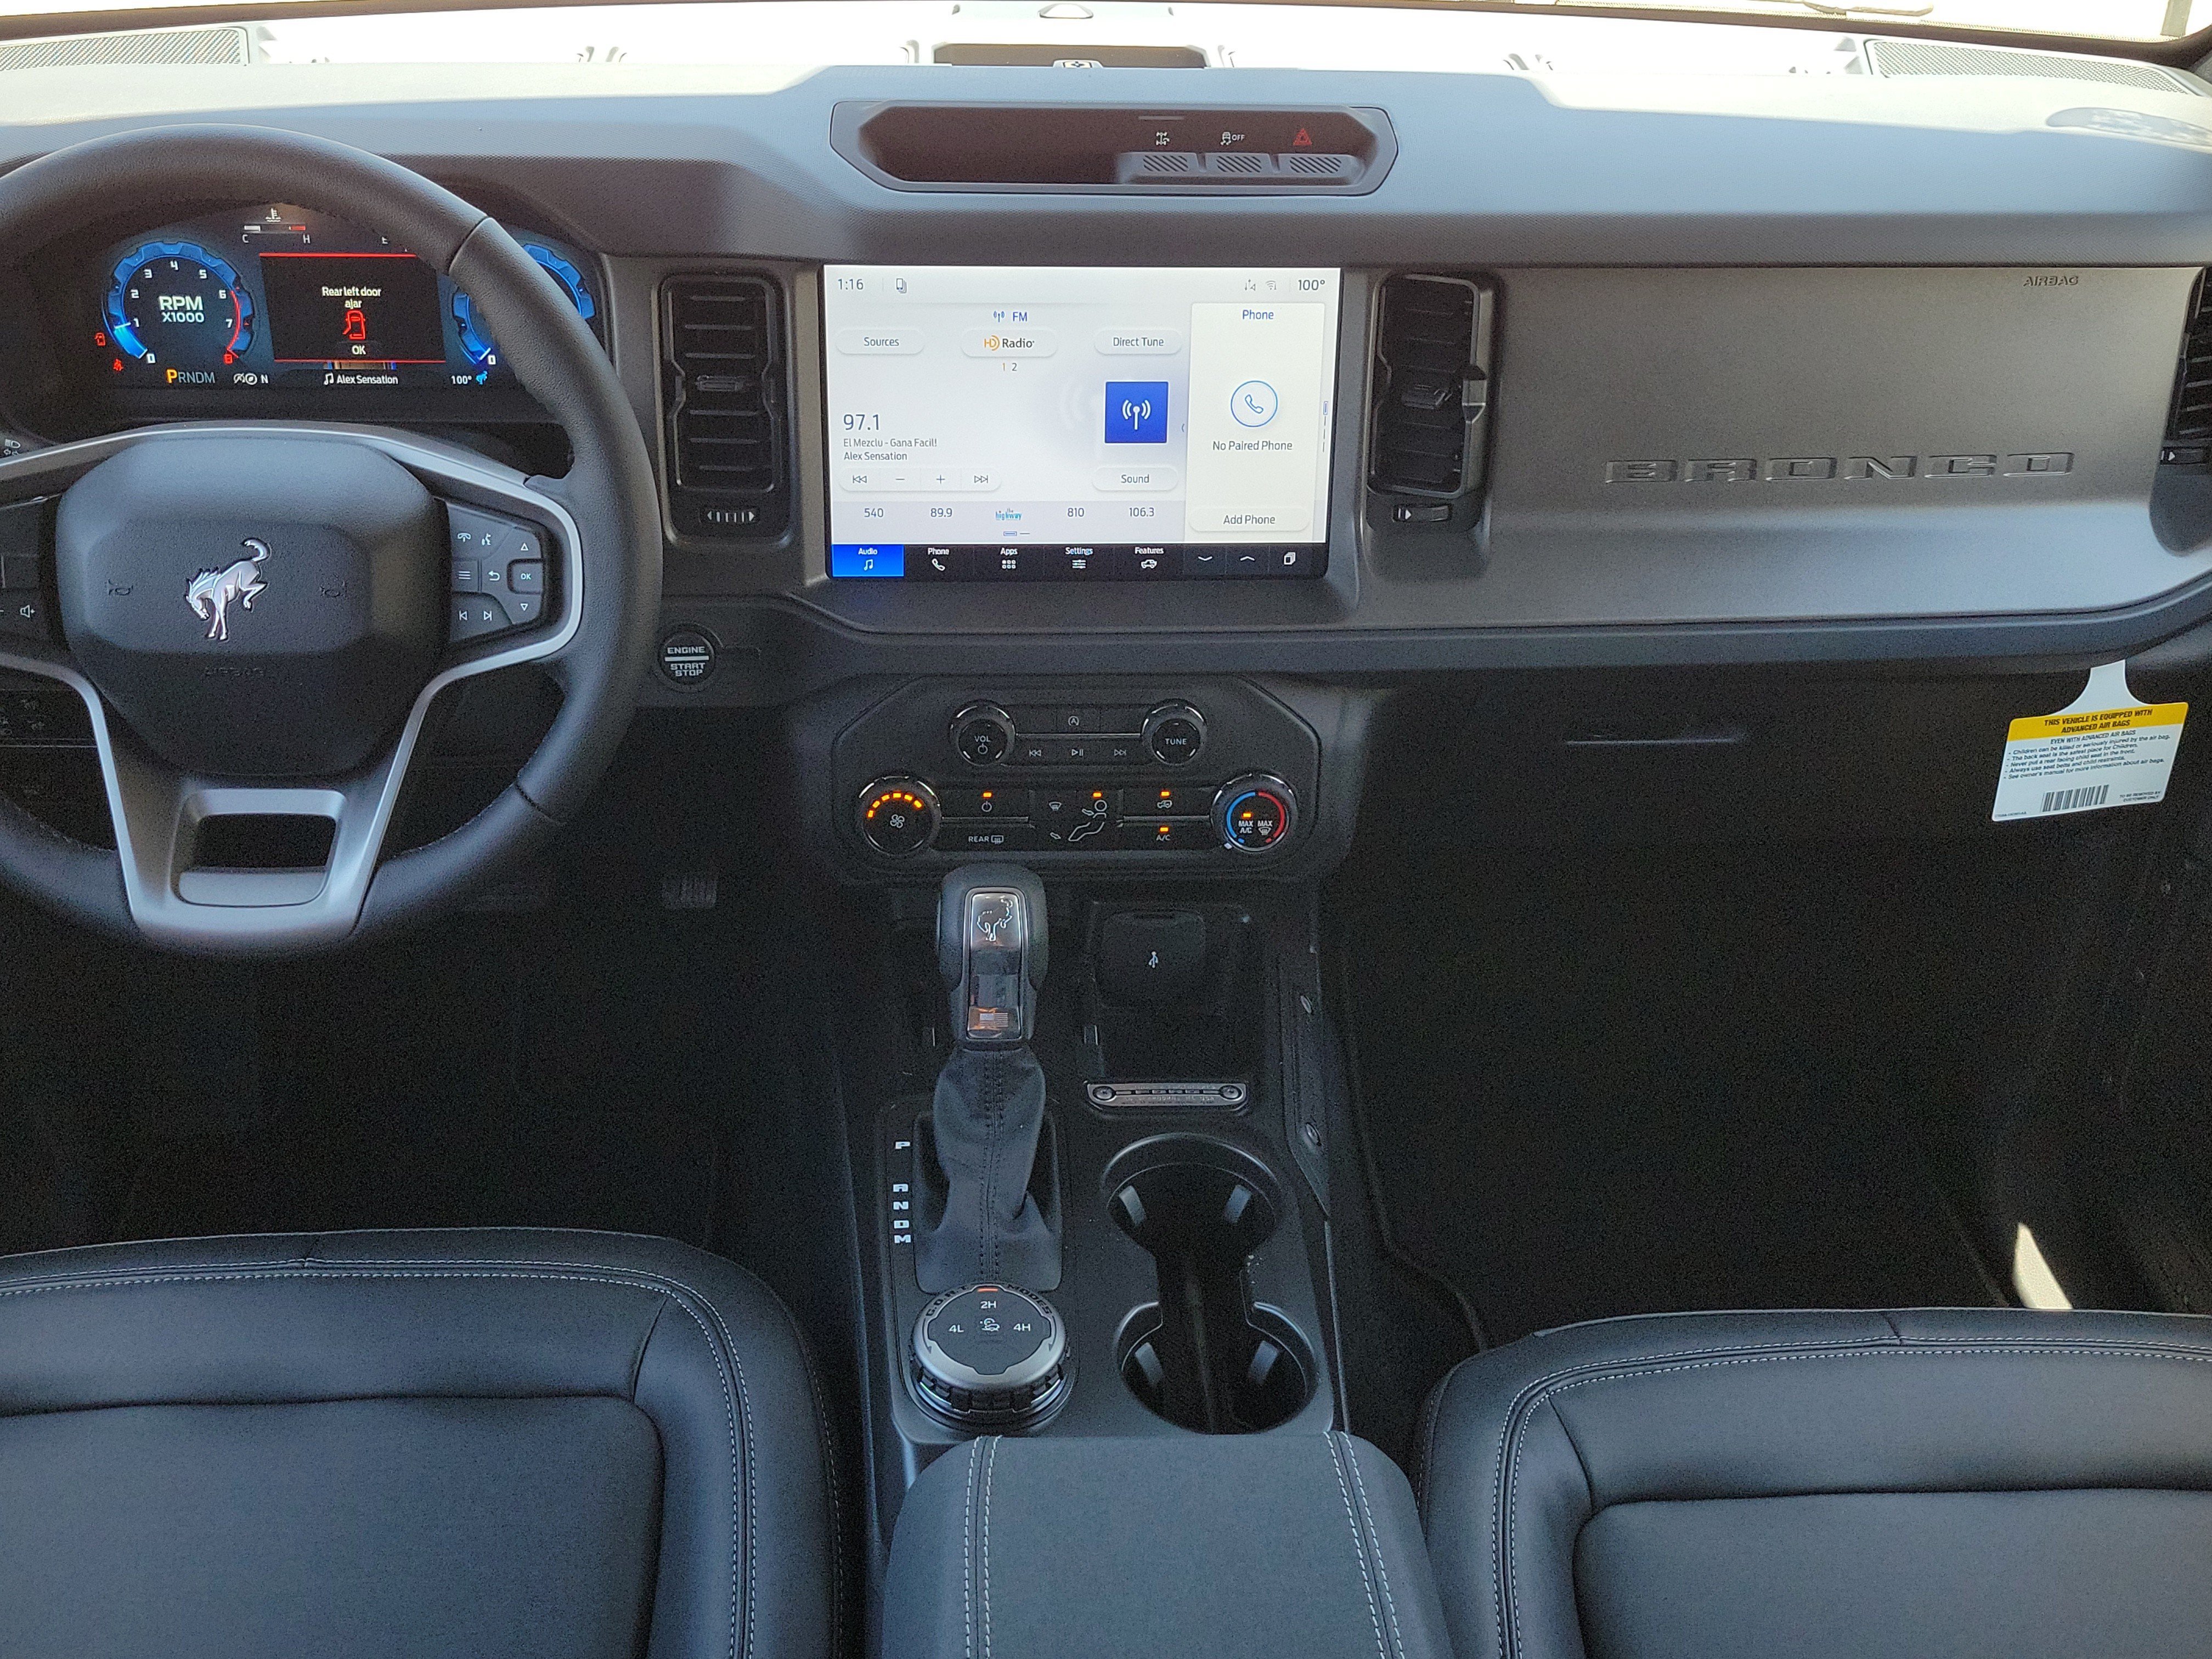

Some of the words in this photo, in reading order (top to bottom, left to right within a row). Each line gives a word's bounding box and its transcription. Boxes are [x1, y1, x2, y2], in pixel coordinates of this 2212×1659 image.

[242, 235, 249, 244] C
[303, 235, 311, 244] H
[170, 261, 178, 270] 4
[144, 269, 153, 278] 3
[199, 269, 207, 279] 5
[838, 279, 864, 290] 1:16
[1298, 280, 1325, 291] 100°
[2023, 276, 2079, 286] AIRBAG
[131, 290, 139, 298] 2
[219, 290, 226, 298] 6
[322, 287, 342, 297] Rear
[344, 286, 359, 297] left
[361, 286, 381, 297] door
[159, 296, 203, 311] RPM
[345, 300, 362, 309] ajar
[162, 312, 204, 323] X1000
[1012, 312, 1028, 322] FM
[1243, 310, 1274, 320] Phone
[133, 318, 139, 327] 1
[225, 318, 233, 328] 7
[864, 337, 899, 347] Sources
[1002, 338, 1033, 348] Radio
[1113, 337, 1139, 347] Direct
[1142, 337, 1164, 347] Tune
[352, 345, 366, 355] OK
[146, 353, 155, 364] 0
[224, 353, 233, 364] 8
[1002, 363, 1006, 371] 1
[1012, 363, 1017, 371] 2
[261, 374, 268, 383] N
[337, 375, 355, 384] Alex
[357, 375, 398, 384] Sensation
[451, 375, 472, 384] 100°
[843, 414, 880, 431] 97.1
[844, 438, 851, 447] El
[890, 438, 912, 447] Gana
[1212, 441, 1226, 450] No
[1229, 441, 1259, 450] Paired
[1261, 441, 1293, 450] Phone
[844, 452, 863, 461] Alex
[864, 452, 907, 461] Sensation
[1605, 453, 2074, 483] BRONCO
[1121, 474, 1149, 483] Sound
[864, 508, 884, 518] 540
[930, 508, 952, 517] 89.9
[995, 511, 1023, 520] highway
[1067, 508, 1085, 517] 810
[1129, 507, 1155, 517] 106.3
[1223, 515, 1242, 524] Add
[1245, 515, 1276, 524] Phone
[1000, 548, 1018, 556] Apps
[1065, 548, 1093, 556] Settings
[2045, 718, 2059, 726] THIS
[2062, 715, 2091, 724] VEHICLE
[2100, 711, 2132, 720] EQUIPPED
[2135, 709, 2153, 717] WITH
[2061, 724, 2097, 733] ADVANCED
[893, 1183, 908, 1192] R
[893, 1201, 909, 1210] N
[894, 1220, 909, 1228] D
[894, 1235, 911, 1243] M
[949, 1324, 964, 1333] 4L
[1013, 1323, 1030, 1331] 4H
